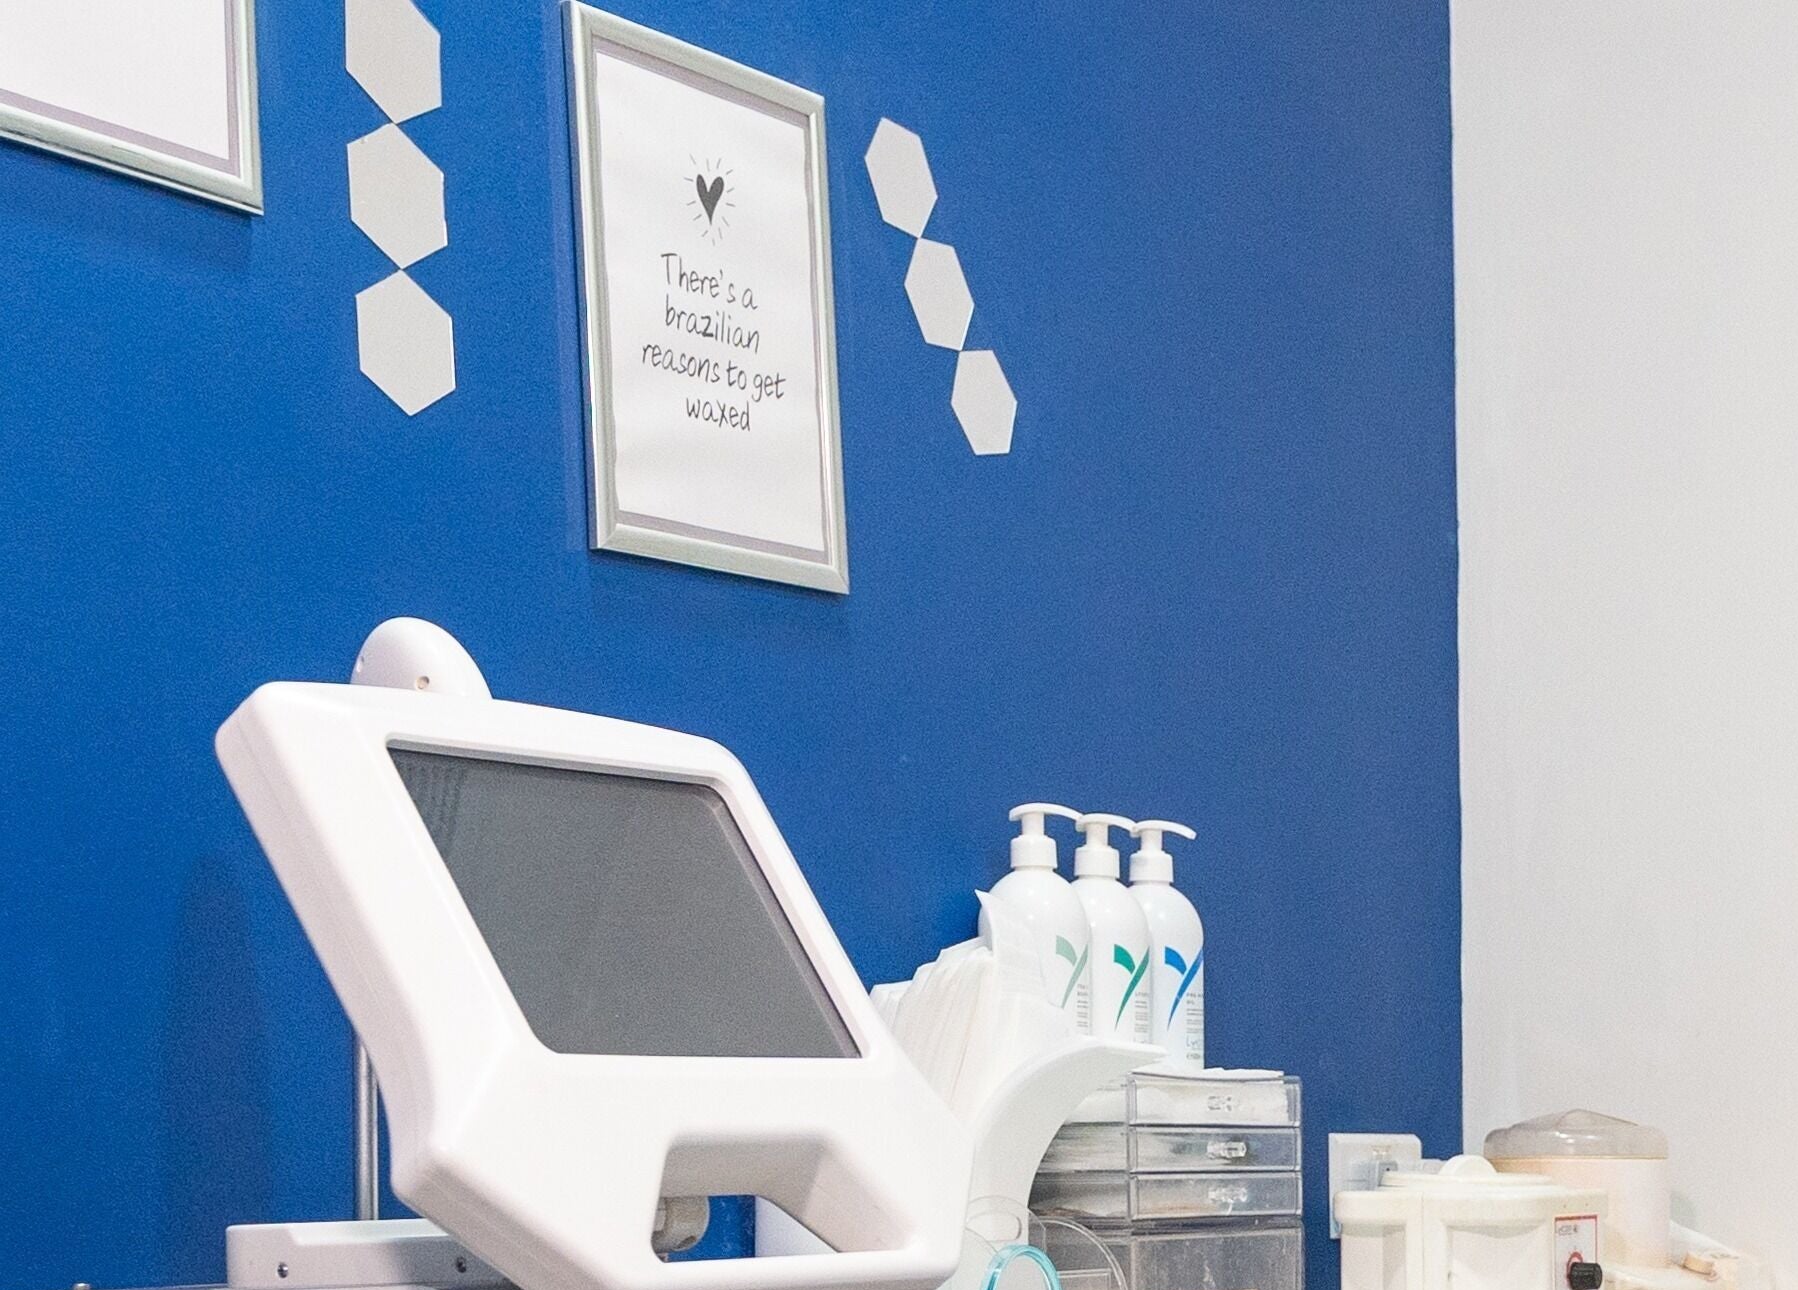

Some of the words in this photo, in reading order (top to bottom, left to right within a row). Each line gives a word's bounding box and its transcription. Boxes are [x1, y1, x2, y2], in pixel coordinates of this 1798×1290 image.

[661, 252, 736, 303] There's
[742, 288, 758, 310] a
[665, 293, 760, 353] brazilian
[642, 344, 721, 383] reasons
[726, 360, 747, 390] to
[752, 372, 786, 402] get
[686, 397, 751, 431] waxed
